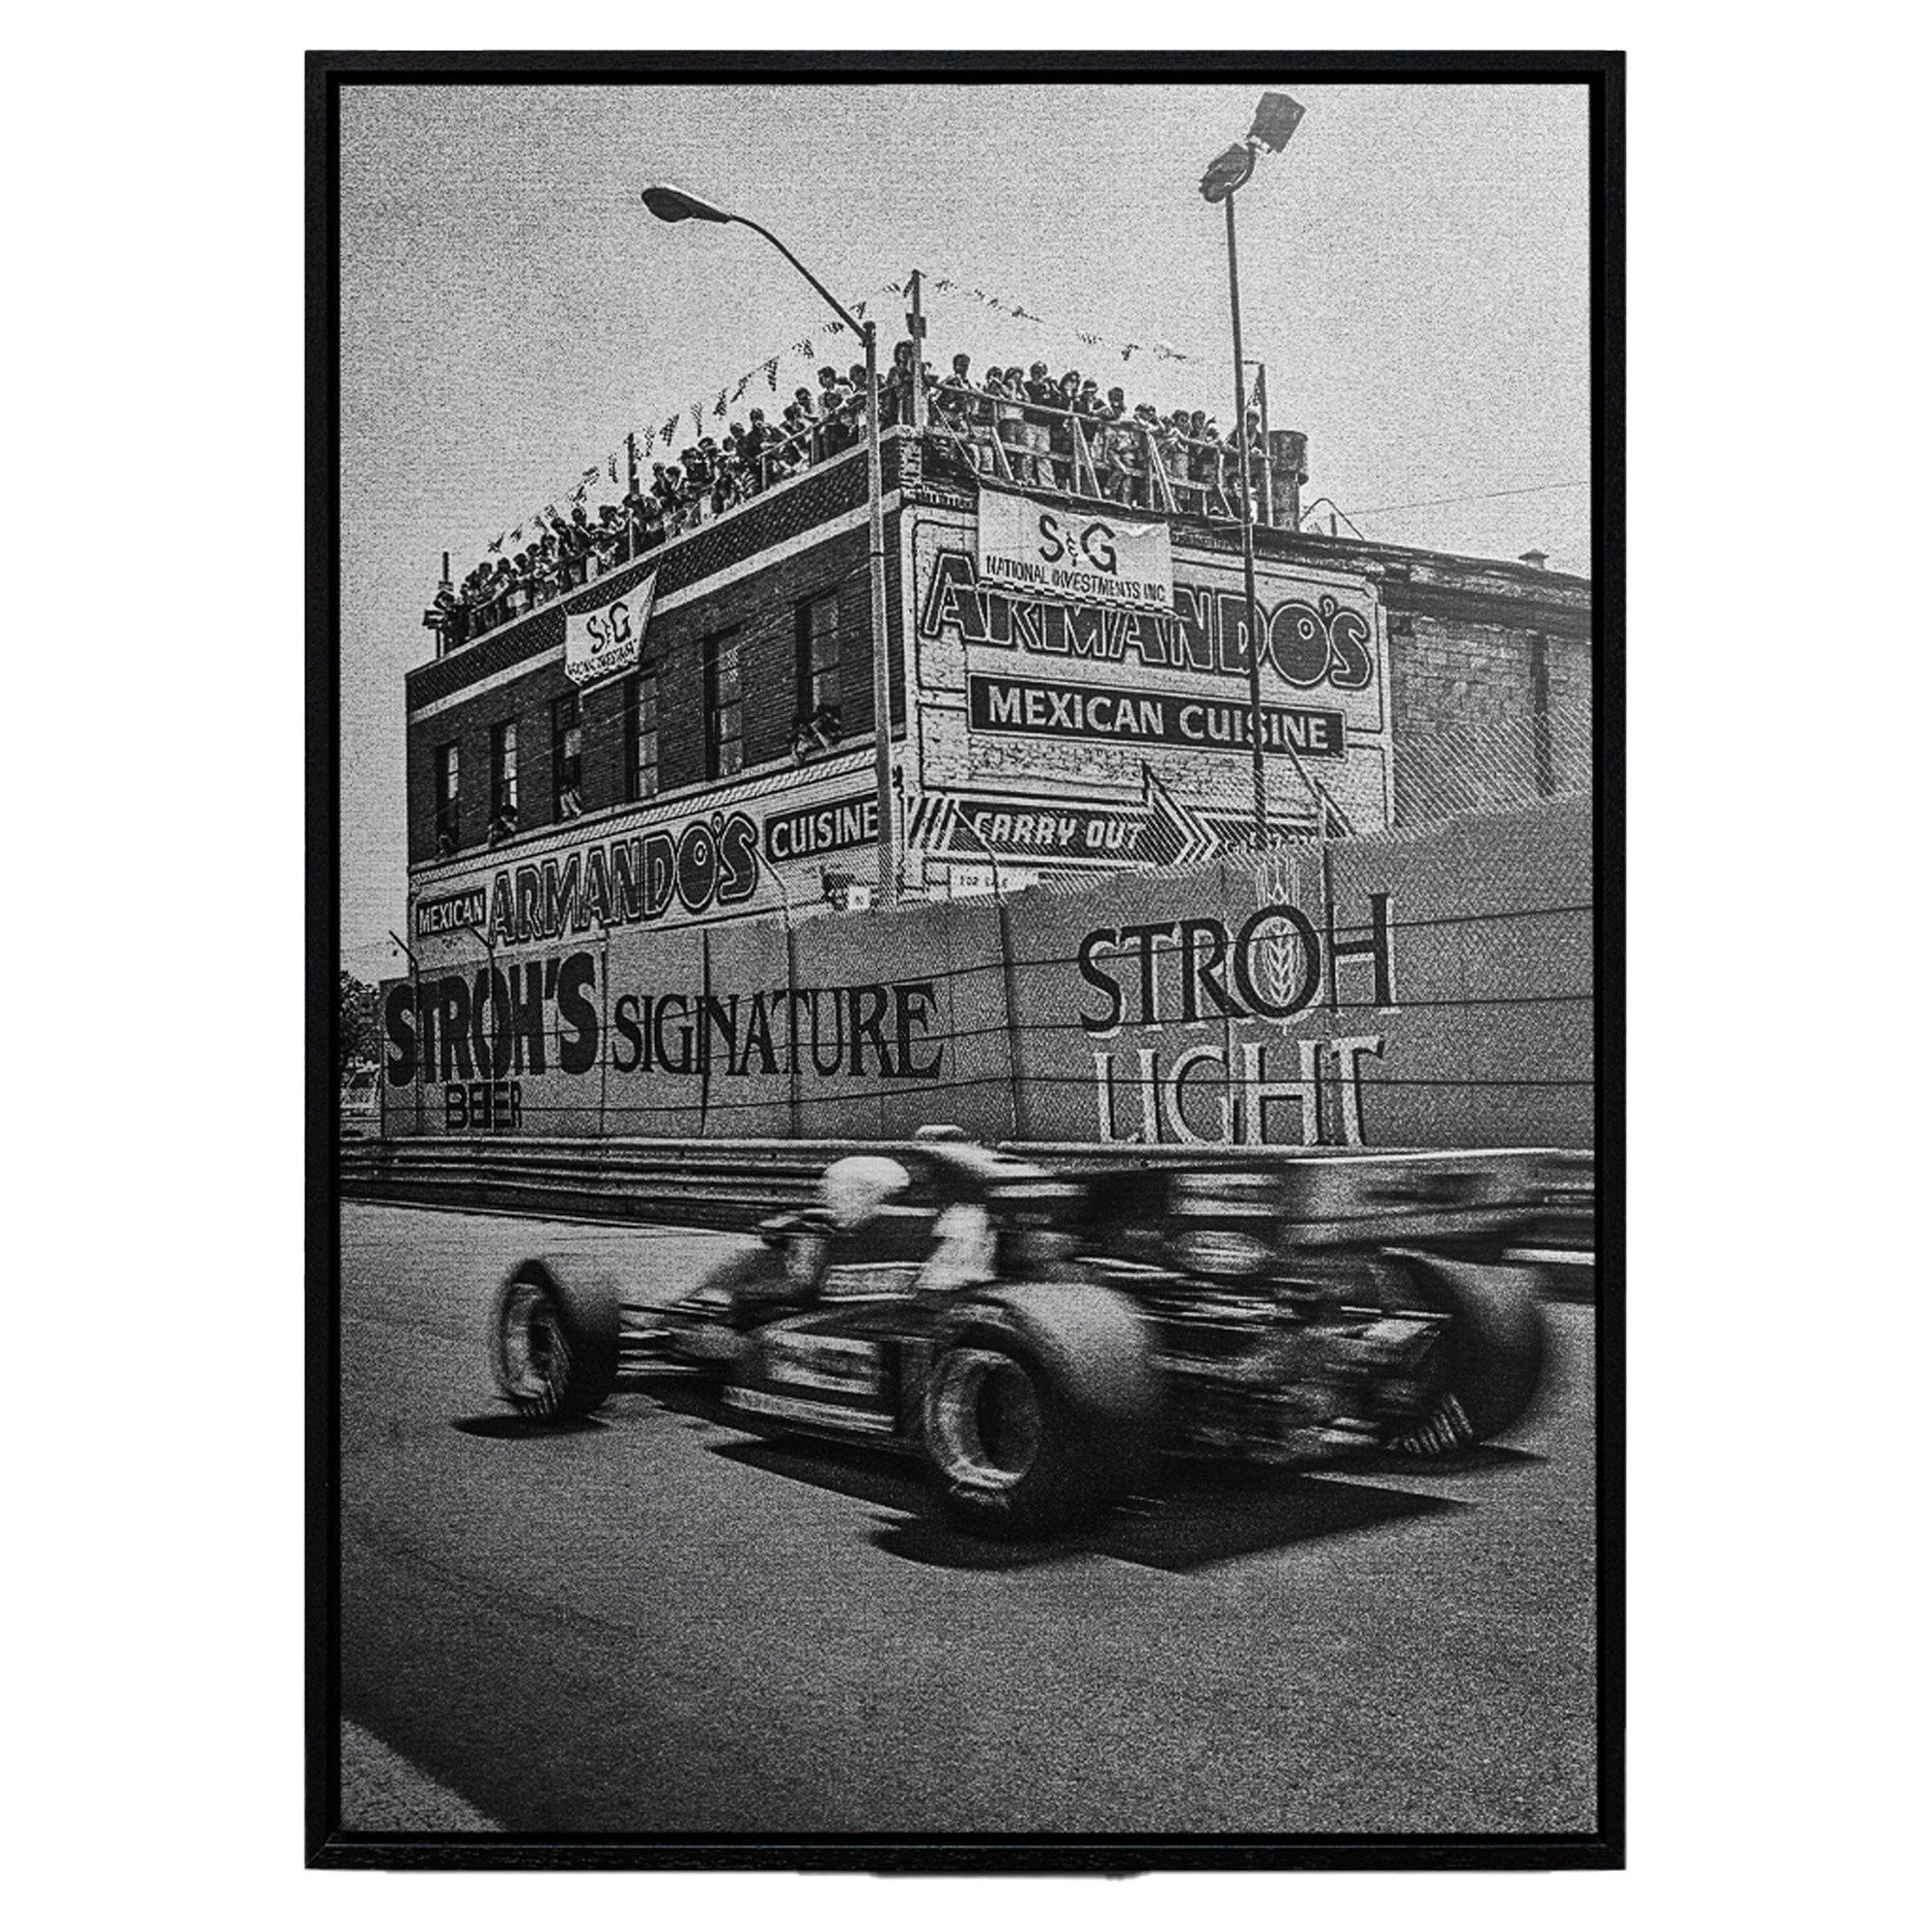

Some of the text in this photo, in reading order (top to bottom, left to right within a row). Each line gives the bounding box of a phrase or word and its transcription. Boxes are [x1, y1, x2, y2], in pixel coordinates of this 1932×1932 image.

[923, 552, 1371, 688] ARMANDO'S
[986, 554, 1050, 585] NATIONAL
[1052, 569, 1140, 601] INVESTMENTS
[989, 689, 1328, 749] MEXICAN CUISINE
[418, 803, 879, 948] MEXICAN ARMANDO'S CUISINE
[974, 810, 1147, 850] CARRY OUT
[385, 952, 943, 1087] STROH'S SIGNATURE
[1077, 893, 1397, 1037] STROH
[444, 1081, 523, 1129] BEER
[1094, 1037, 1386, 1146] LIGHT
